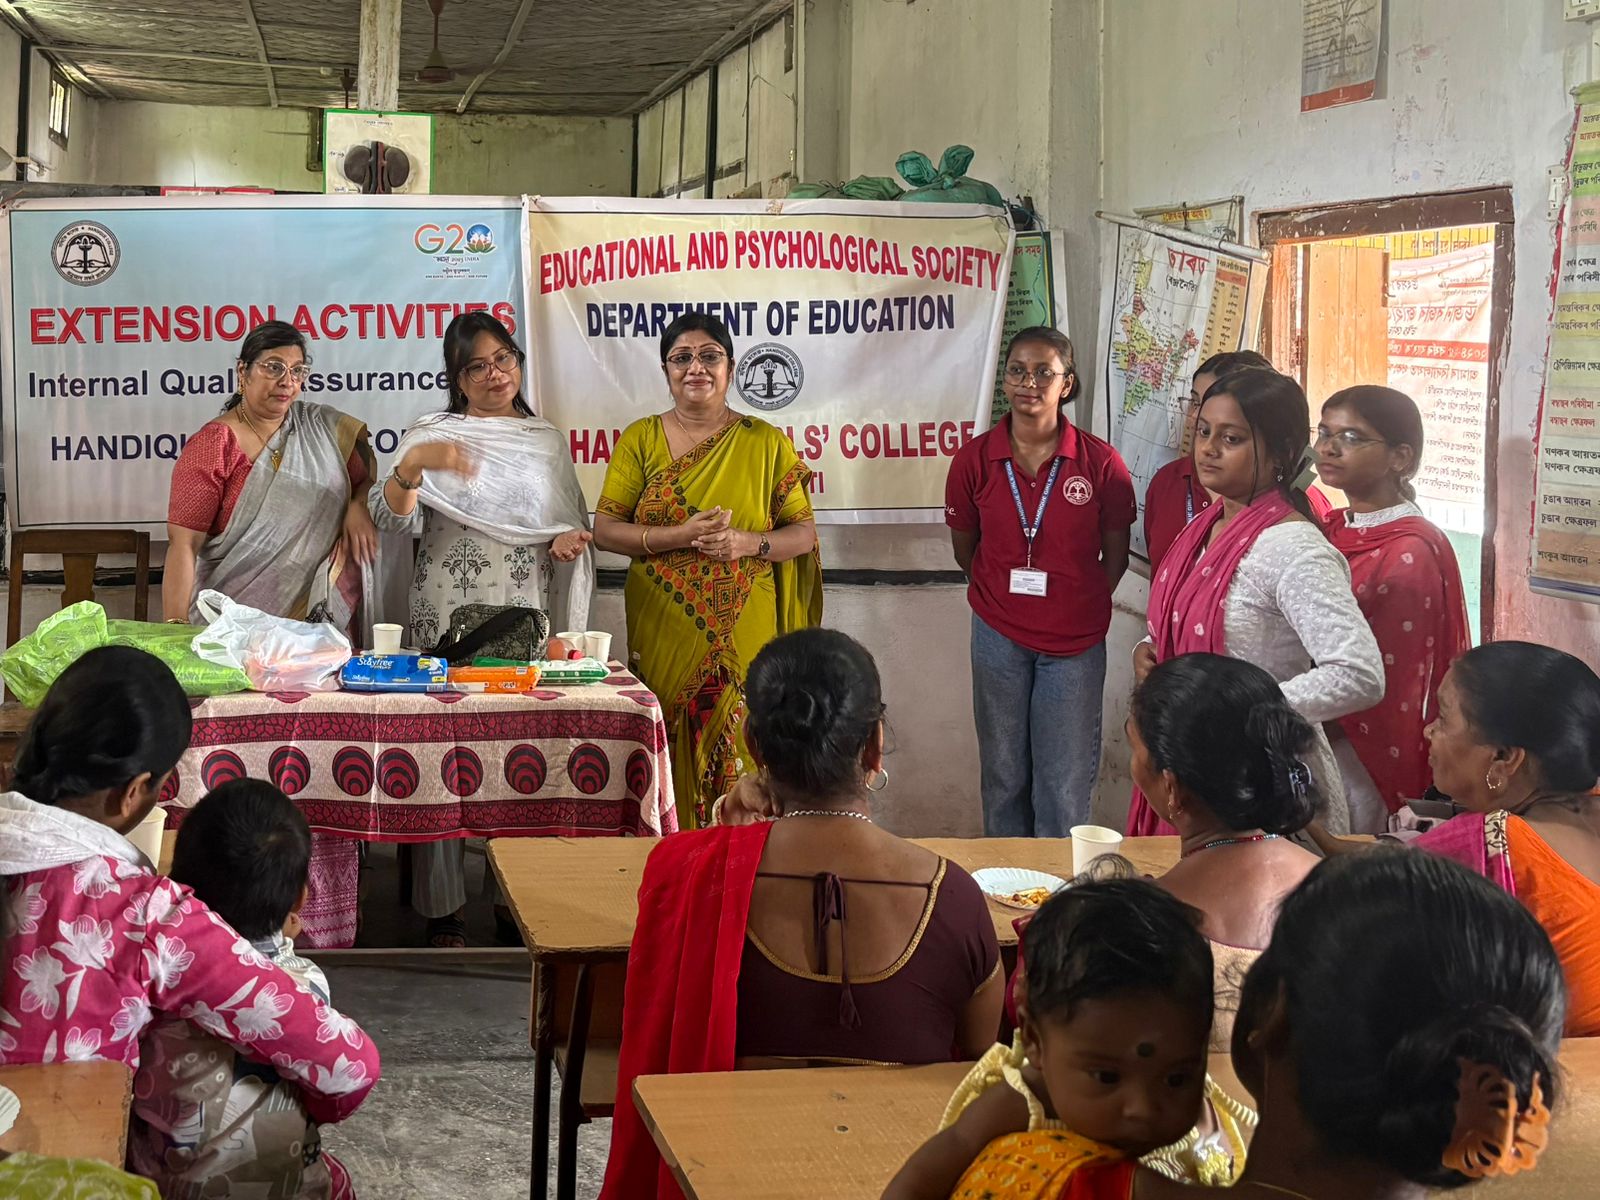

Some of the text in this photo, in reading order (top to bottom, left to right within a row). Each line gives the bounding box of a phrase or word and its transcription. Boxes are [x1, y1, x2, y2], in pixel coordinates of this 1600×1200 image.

[540, 230, 1001, 294] EDUCATIONAL AND PSYCHOLOGICAL SOCIETY
[290, 302, 517, 340] ACTIVITS
[766, 301, 800, 336] OF
[808, 294, 954, 335] EDUCATION
[29, 368, 451, 398] Internal Qual ssurance
[51, 434, 186, 460] HANDIQ
[840, 421, 975, 460] COLLEGE
[357, 656, 394, 667] Stayfree
